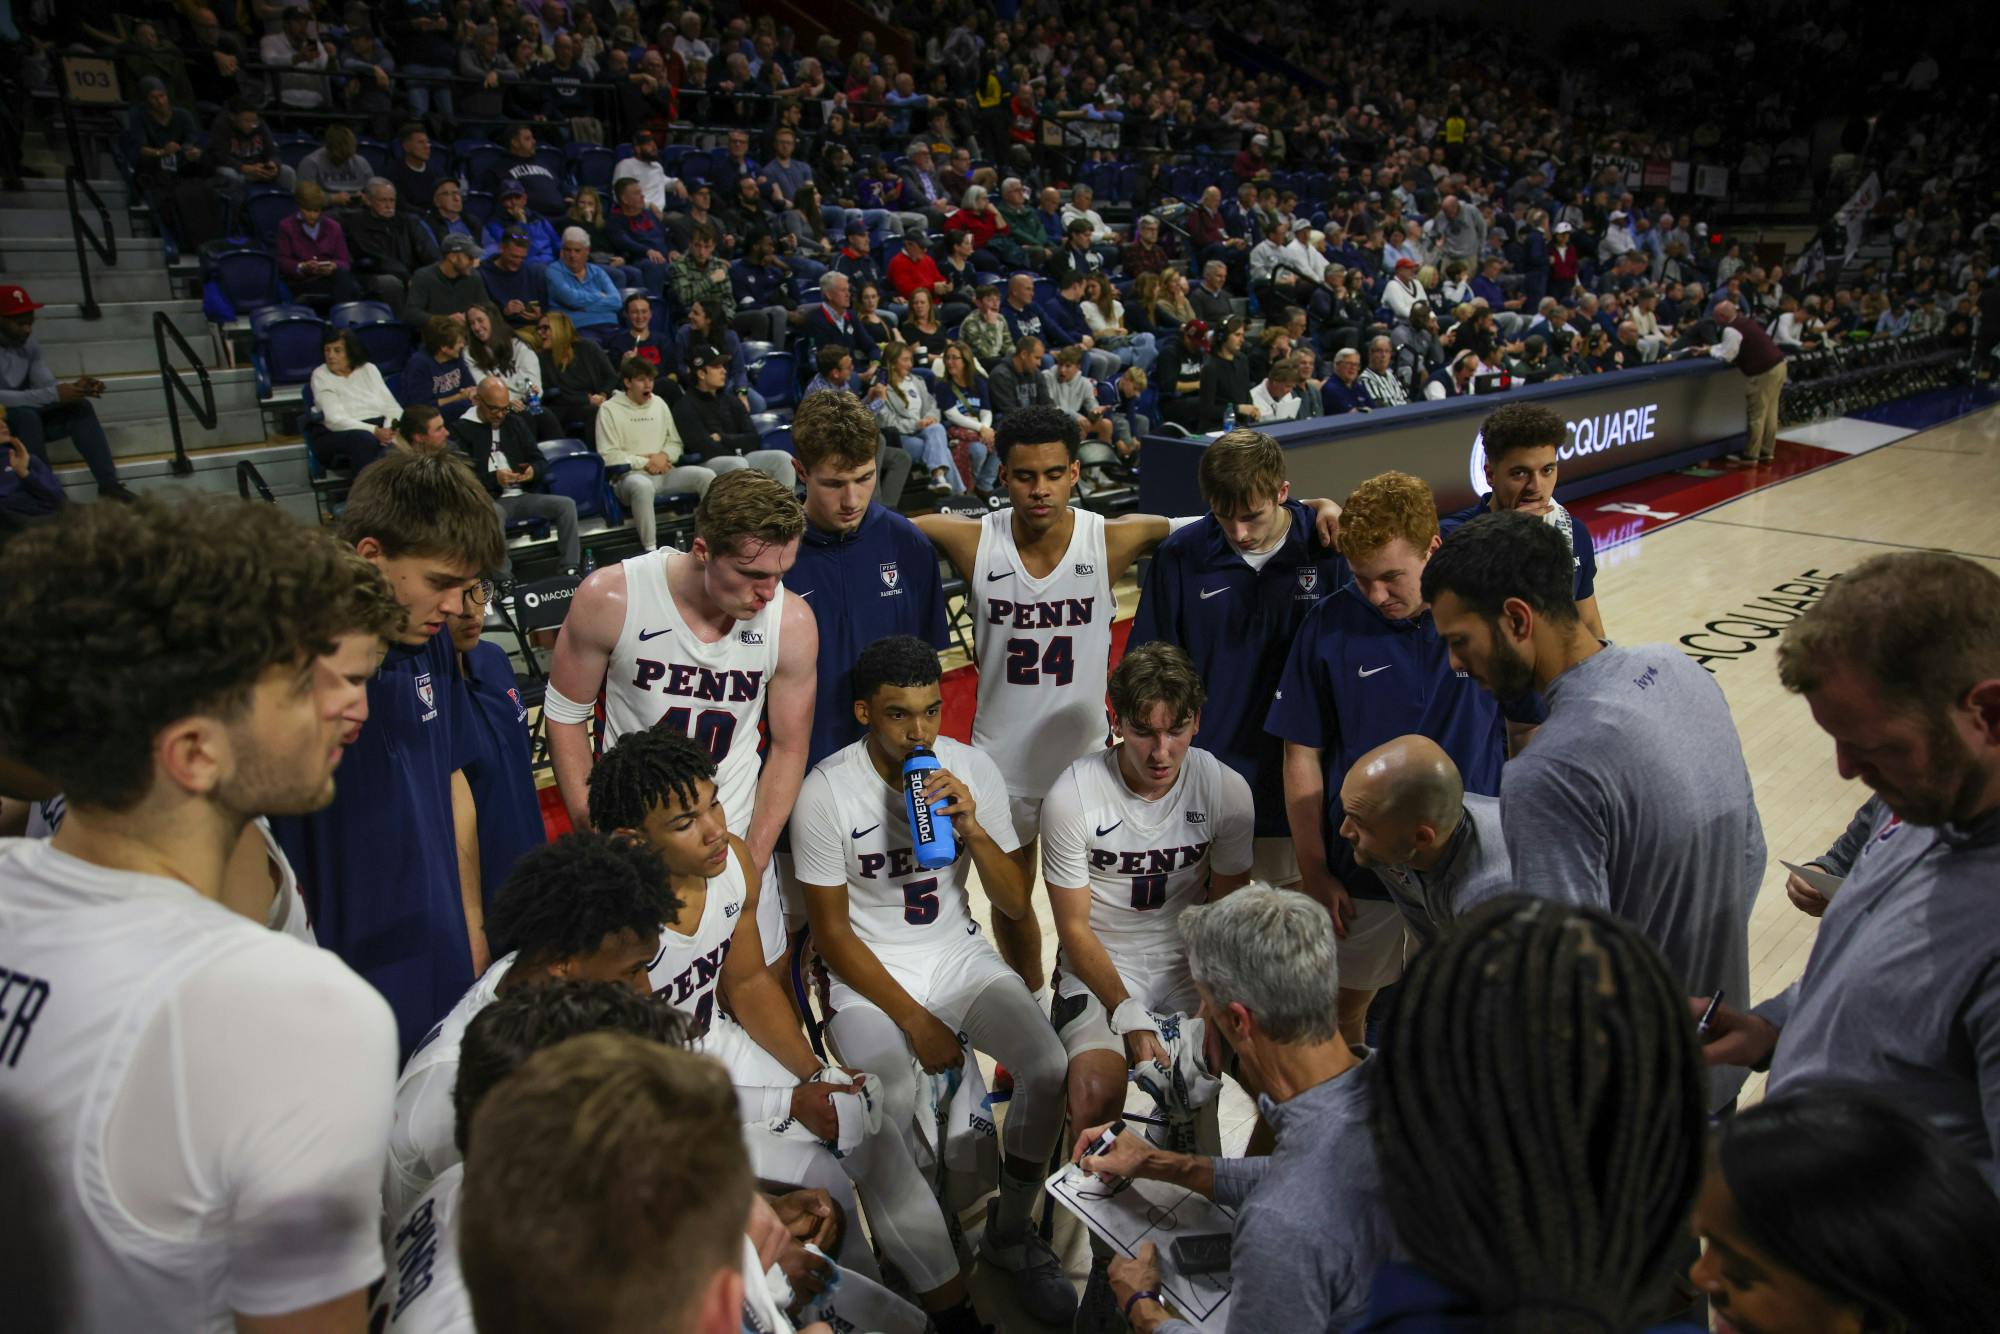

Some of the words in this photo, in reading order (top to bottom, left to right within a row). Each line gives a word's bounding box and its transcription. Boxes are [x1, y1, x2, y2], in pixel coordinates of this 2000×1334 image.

[74, 71, 110, 88] 103
[1556, 404, 1658, 462] CQUARIE
[987, 597, 1095, 629] PENN
[632, 658, 763, 702] PENN
[1007, 636, 1075, 687] 24
[1090, 841, 1210, 875] PENN
[903, 877, 940, 925] 5
[1130, 873, 1168, 912] 0
